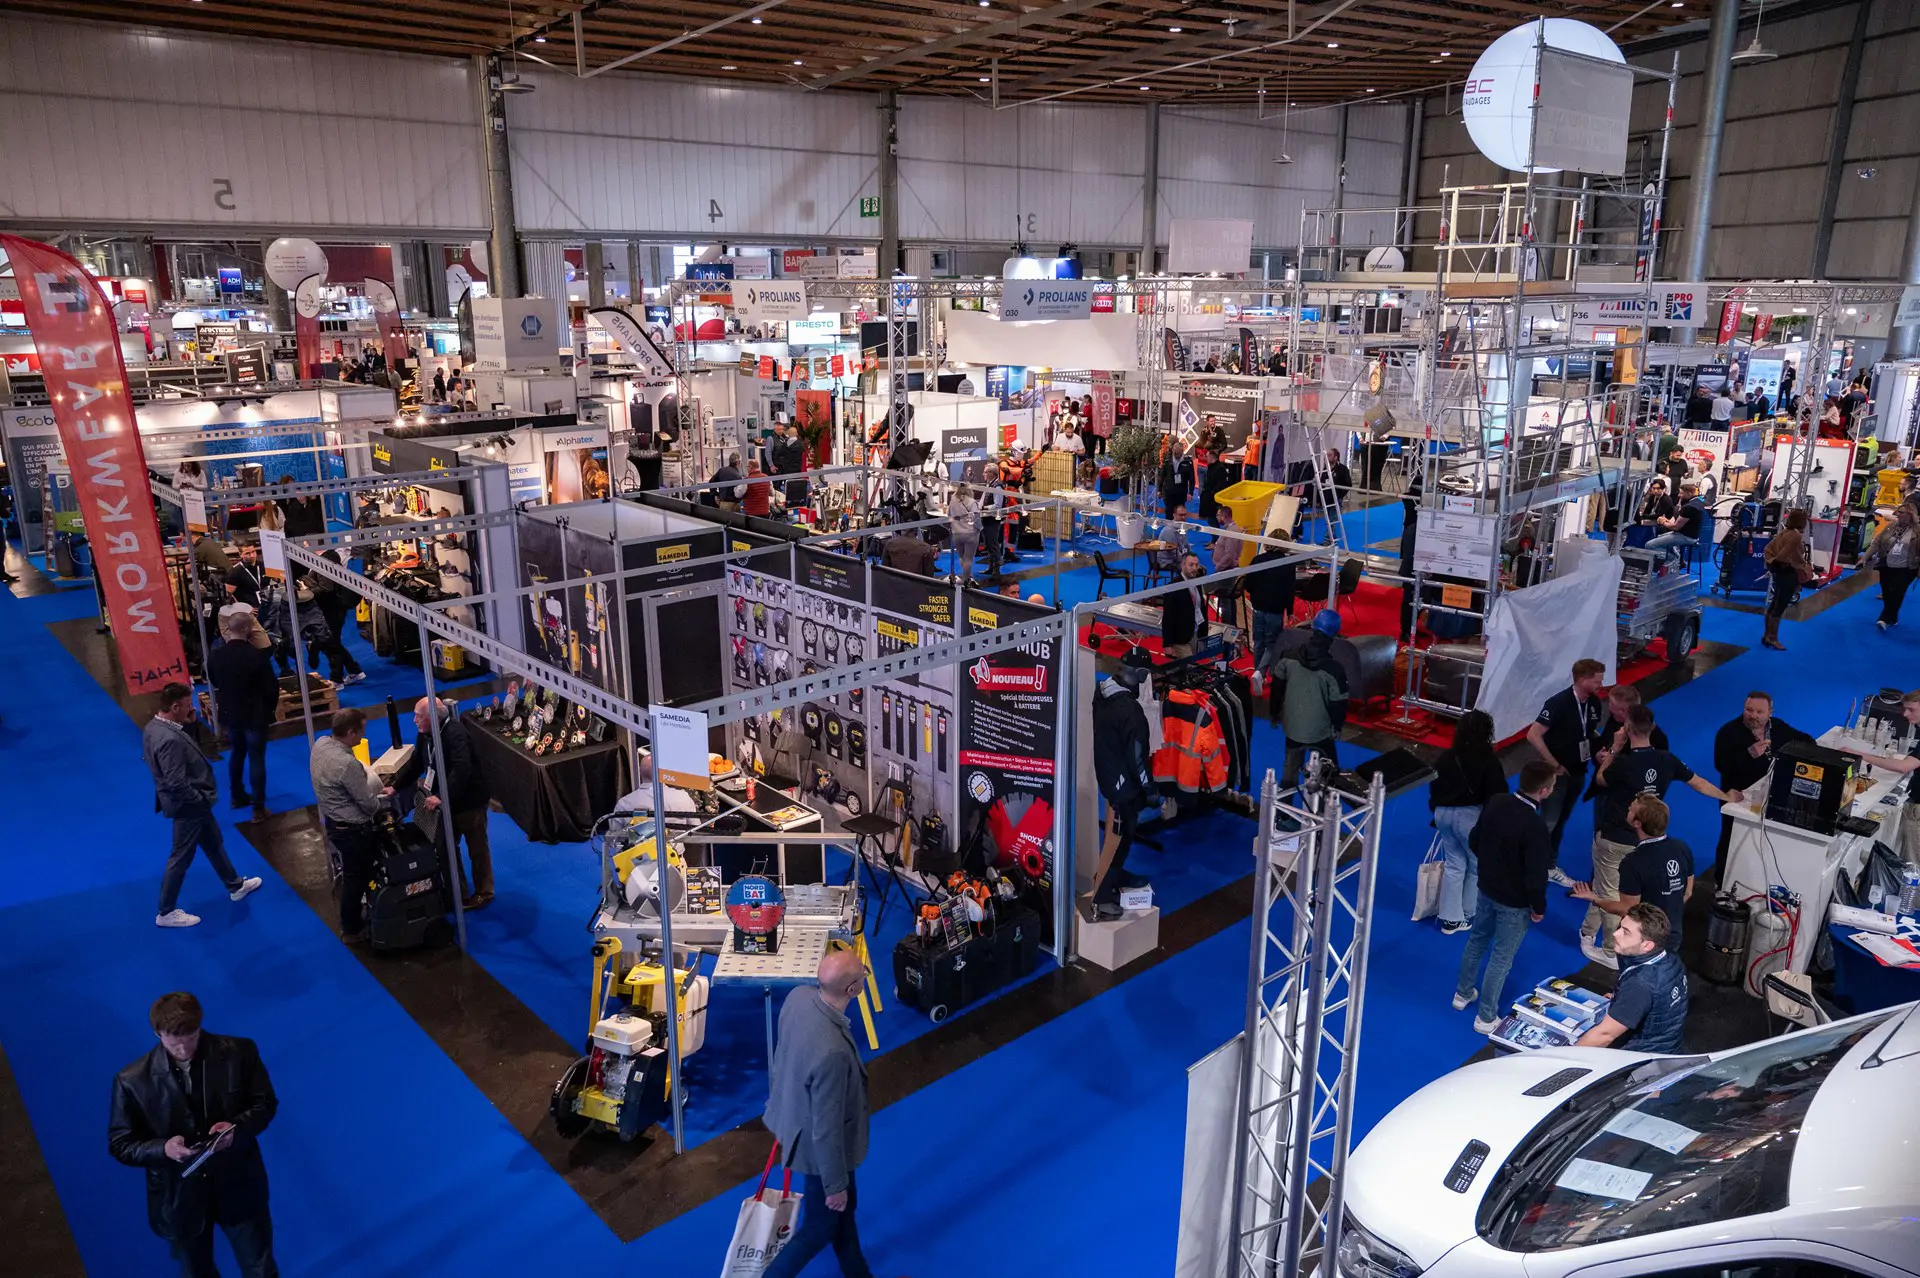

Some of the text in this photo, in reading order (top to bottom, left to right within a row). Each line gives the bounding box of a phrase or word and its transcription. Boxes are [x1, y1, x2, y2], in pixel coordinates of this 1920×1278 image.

[759, 291, 801, 303] PROLIANS
[1038, 291, 1087, 302] PROLIANS
[1664, 293, 1674, 319] MASTER
[1674, 293, 1693, 301] PRO
[796, 320, 834, 328] PRESTO
[950, 436, 979, 444] OPSIAL
[1683, 430, 1723, 443] Millon
[658, 551, 688, 561] SAMEDIA
[928, 596, 949, 604] FASTER
[918, 605, 948, 614] STRONGER
[932, 614, 951, 623] SAFER
[970, 616, 996, 627] SAMEDIA
[992, 674, 1034, 685] NOUVEAU
[1018, 694, 1053, 703] DÉCOUPEUSES
[660, 712, 691, 723] SAMEDIA
[662, 774, 676, 782] P24
[745, 890, 764, 898] BAT
